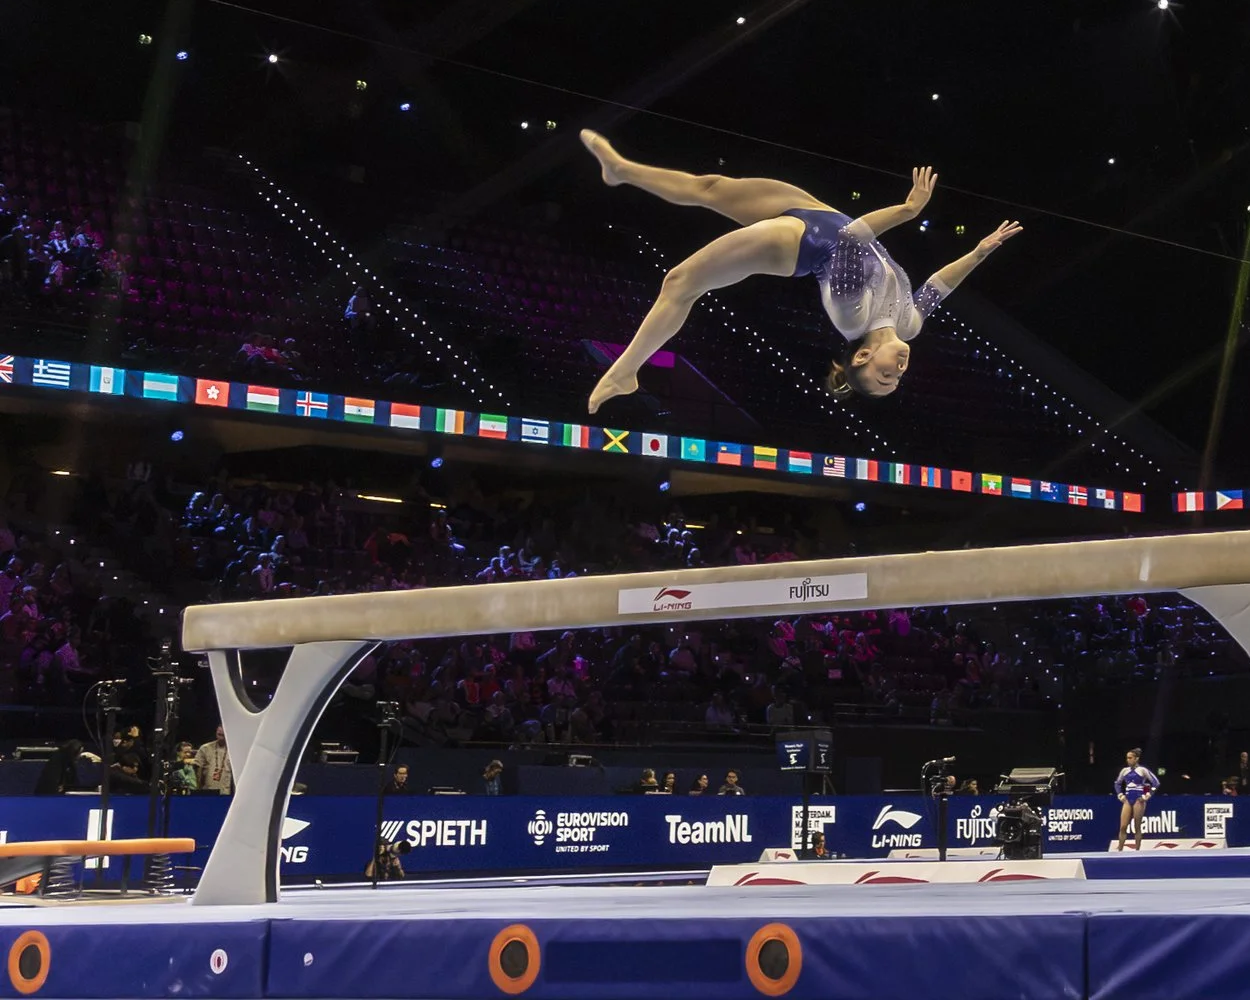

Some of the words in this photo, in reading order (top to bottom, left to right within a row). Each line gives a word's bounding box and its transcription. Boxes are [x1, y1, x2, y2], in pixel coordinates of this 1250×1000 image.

[790, 578, 829, 601] FUJITSU
[557, 812, 628, 826] EUROVISION
[1049, 809, 1093, 820] EUROVISION
[406, 820, 487, 847] SPIETH
[665, 815, 752, 843] TeamNL
[1049, 821, 1073, 832] SPORT
[556, 828, 596, 842] SPORT
[872, 834, 922, 847] LI-NING
